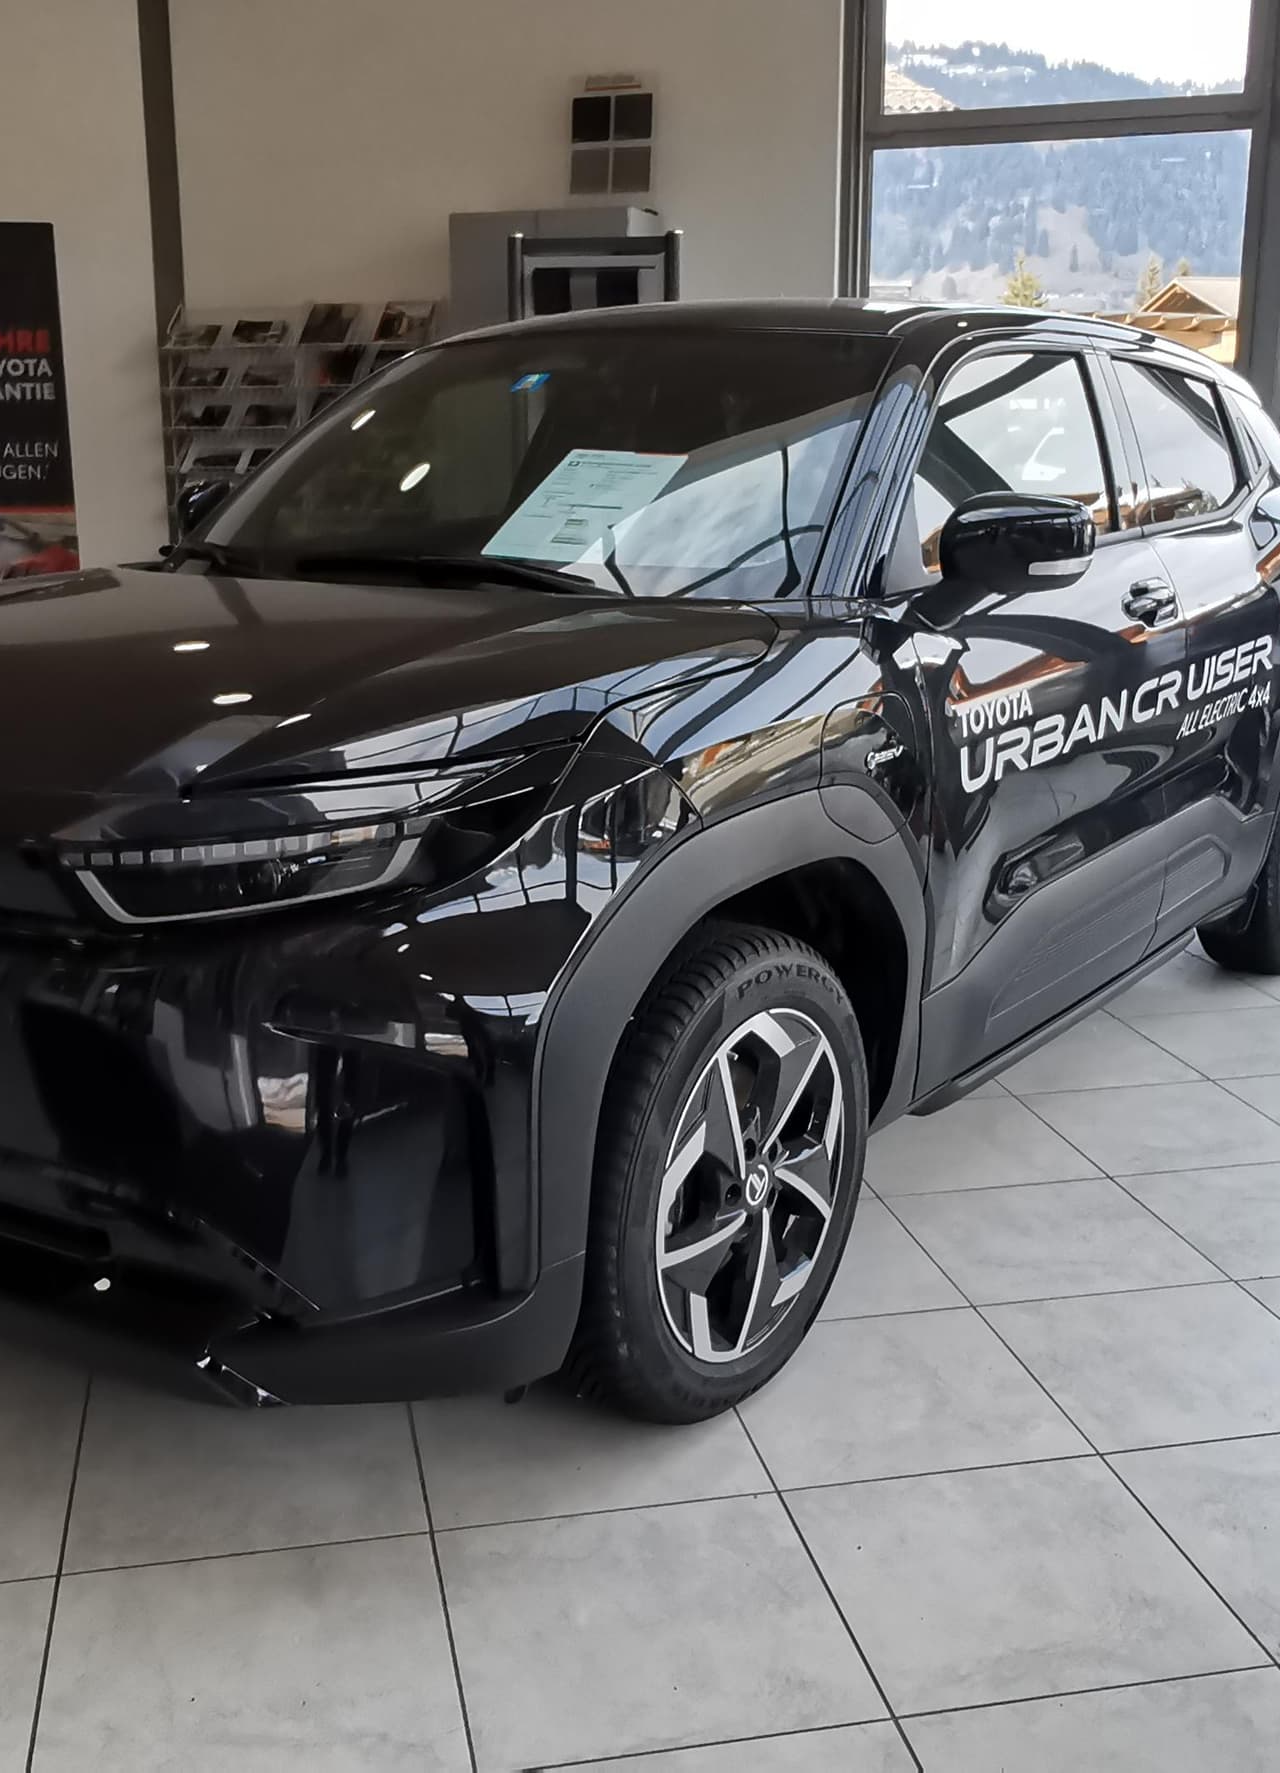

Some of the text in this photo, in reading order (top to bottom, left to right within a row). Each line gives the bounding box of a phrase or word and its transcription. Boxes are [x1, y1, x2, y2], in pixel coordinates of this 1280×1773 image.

[3, 442, 59, 459] ALLEN
[959, 634, 1274, 794] URBAN CRUISER
[959, 692, 1032, 738] TOYOTA
[1176, 680, 1272, 740] ALL ELECTRIC 4x4
[737, 963, 844, 1004] POWERGY
